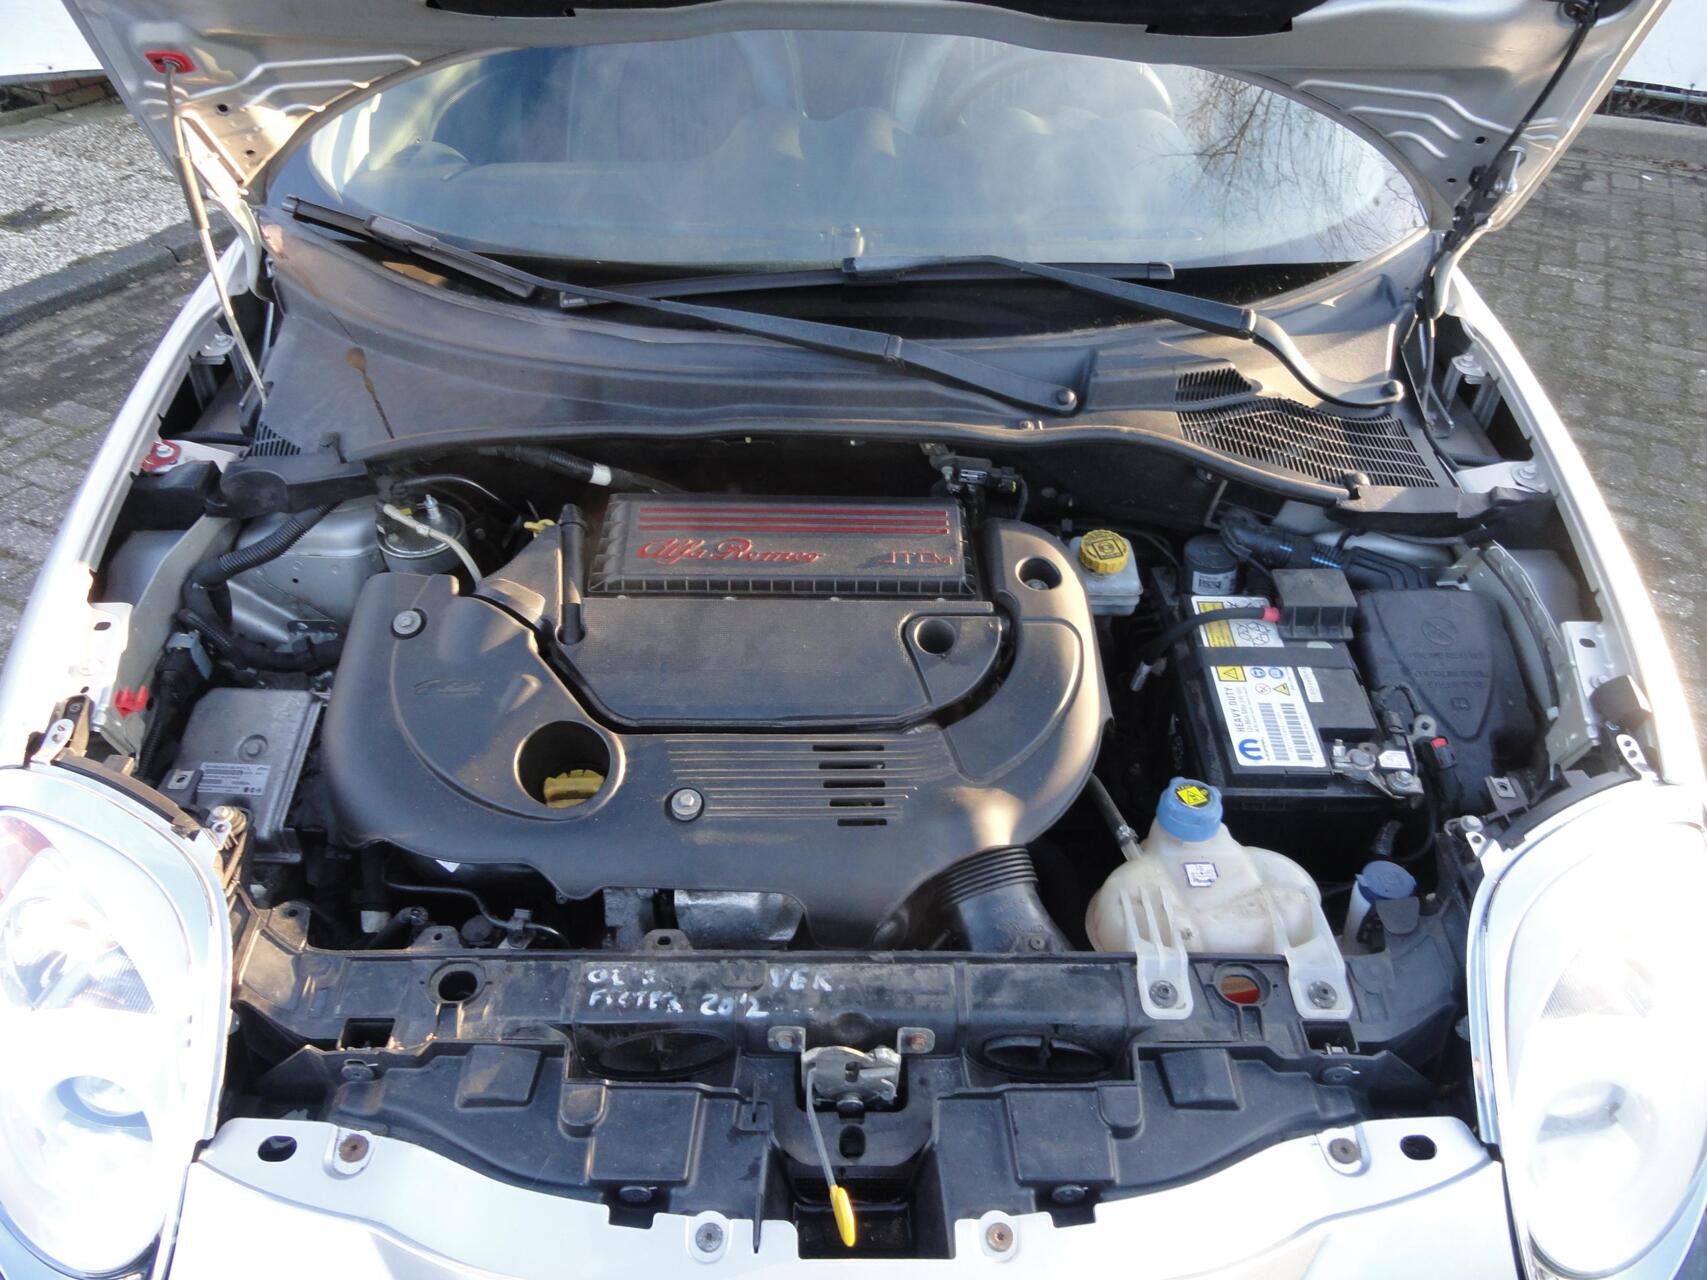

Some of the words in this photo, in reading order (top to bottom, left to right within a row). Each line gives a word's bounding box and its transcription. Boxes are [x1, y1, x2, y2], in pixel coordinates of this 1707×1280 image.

[635, 536, 705, 566] Alfa
[704, 535, 824, 564] Romeo
[1223, 686, 1238, 706] DUTY
[1230, 707, 1246, 732] HEAVY
